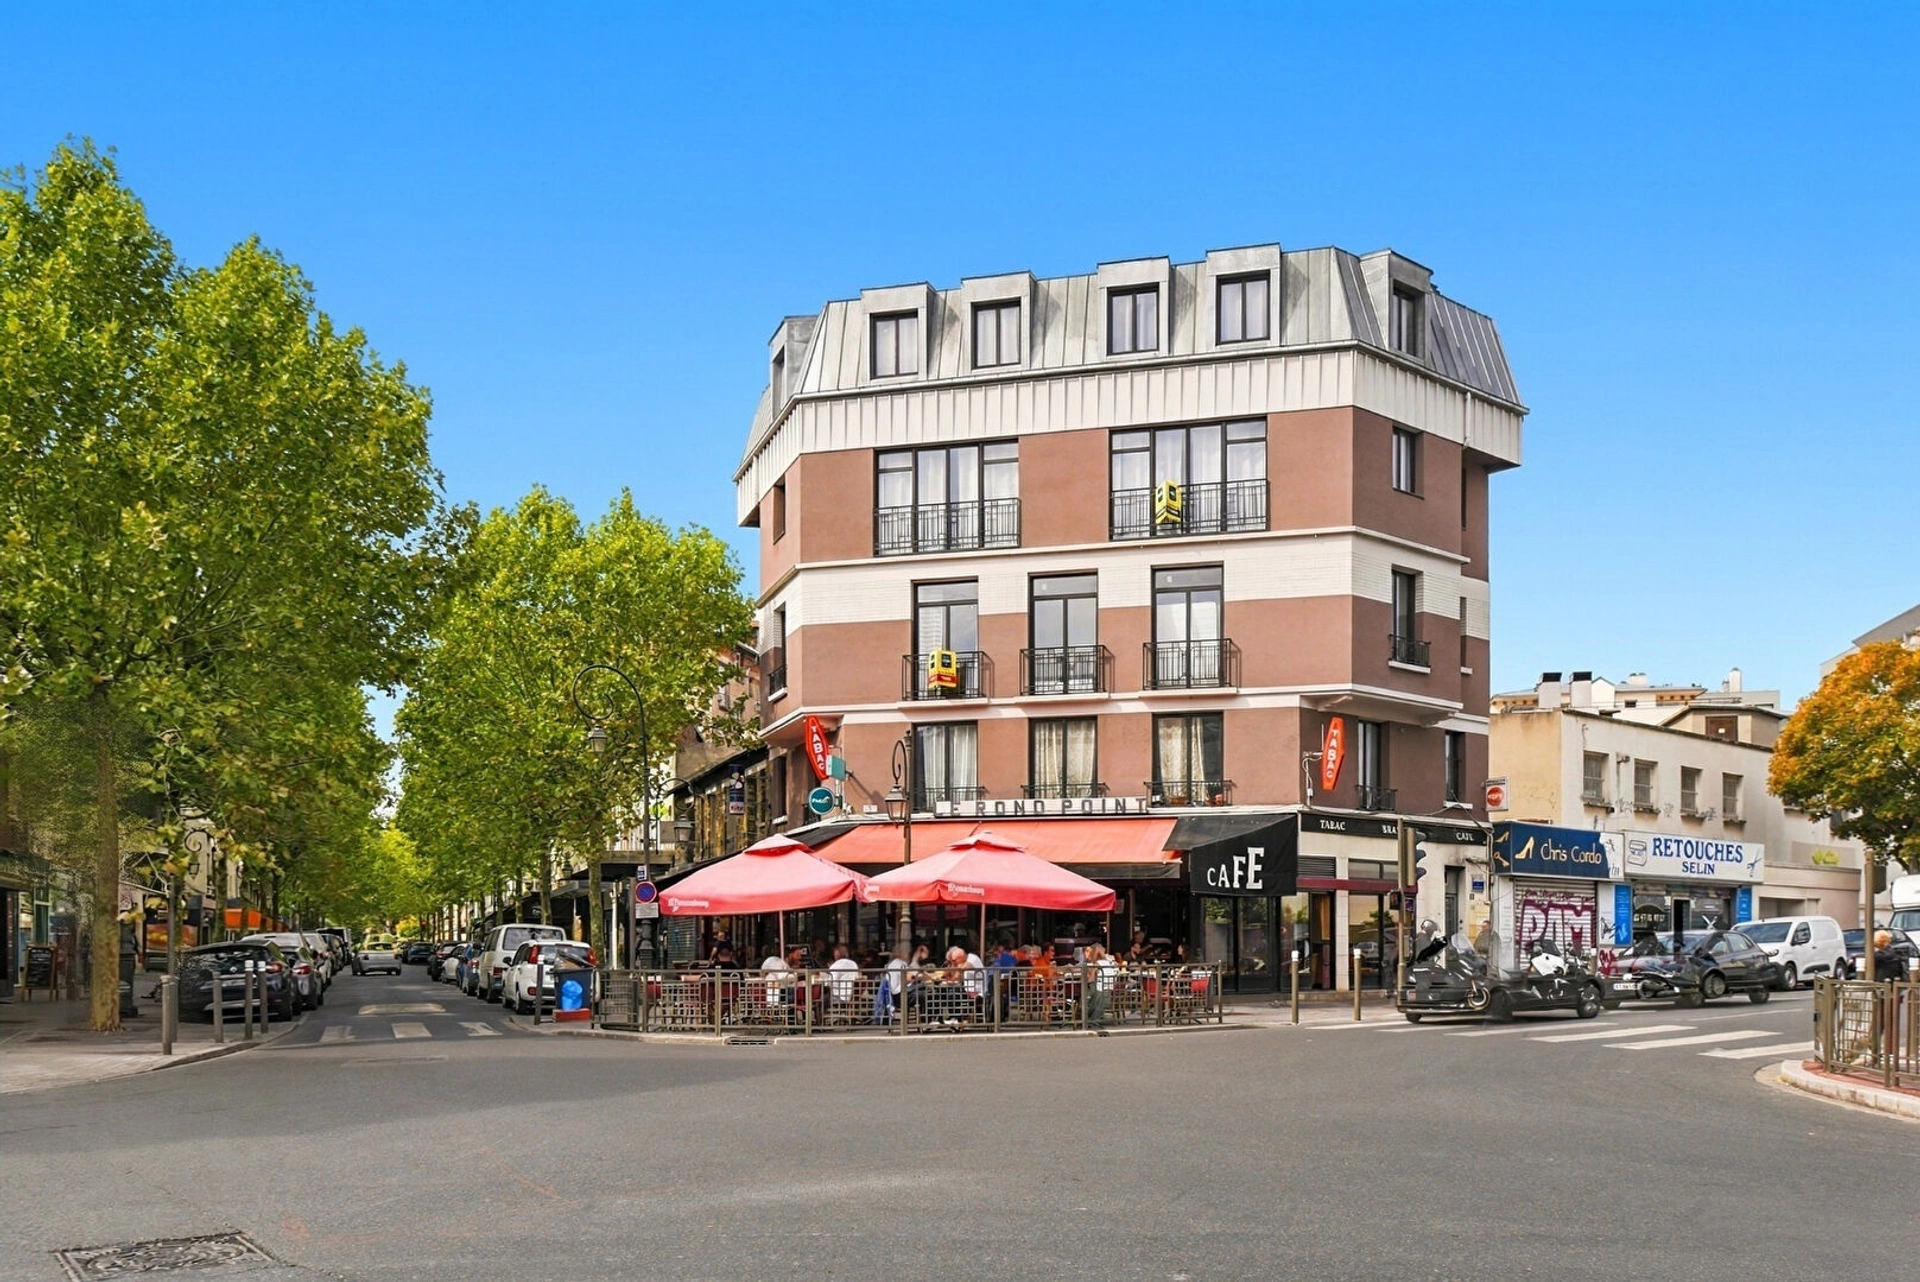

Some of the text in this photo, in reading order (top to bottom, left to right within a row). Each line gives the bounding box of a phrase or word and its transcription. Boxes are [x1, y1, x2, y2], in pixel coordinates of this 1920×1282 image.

[810, 725, 825, 770] TABAC
[1326, 729, 1339, 779] TABAC
[975, 799, 1045, 816] ROND
[1061, 797, 1147, 815] POINT
[1320, 819, 1346, 831] TABAC
[1540, 838, 1568, 862] Chris
[1652, 837, 1744, 864] RETOUCHES
[1207, 846, 1265, 890] CAFE
[1682, 861, 1715, 875] SELIN
